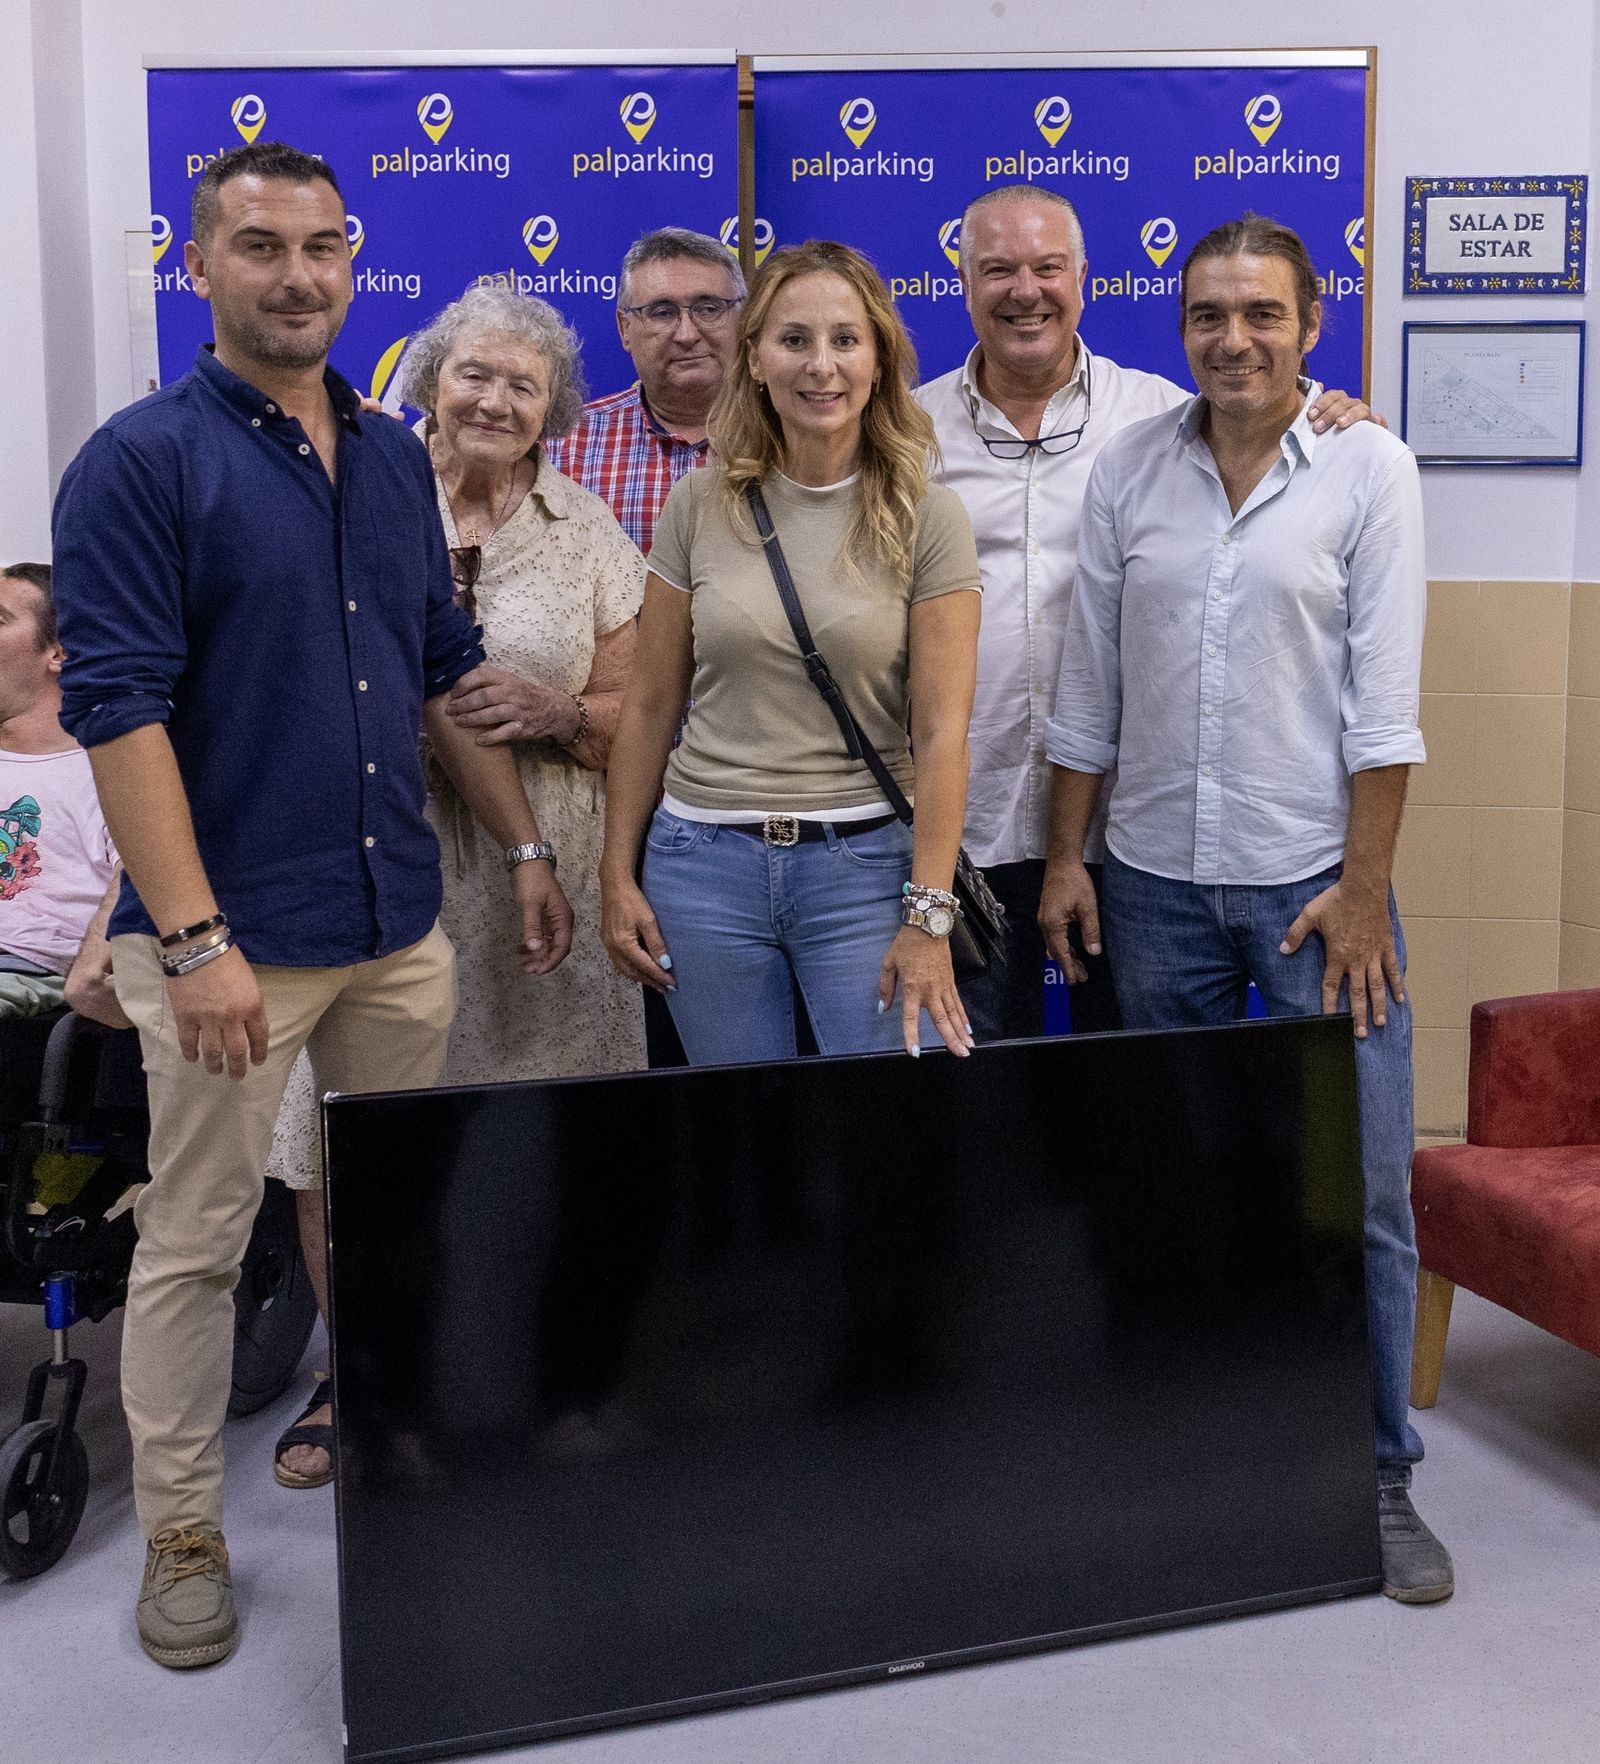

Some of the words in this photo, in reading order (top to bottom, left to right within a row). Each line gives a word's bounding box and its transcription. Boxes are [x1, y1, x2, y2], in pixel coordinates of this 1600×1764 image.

[372, 146, 510, 179] palparking
[573, 146, 714, 179] palparking
[792, 150, 934, 182] palparking
[987, 150, 1129, 182] palparking
[1194, 148, 1340, 181] palparking
[1449, 213, 1508, 231] SALA
[1513, 213, 1544, 231] DE
[1460, 240, 1532, 257] ESTAR
[352, 267, 421, 299] rking
[890, 271, 963, 302] palpa
[888, 1661, 925, 1674] DAEWOO
